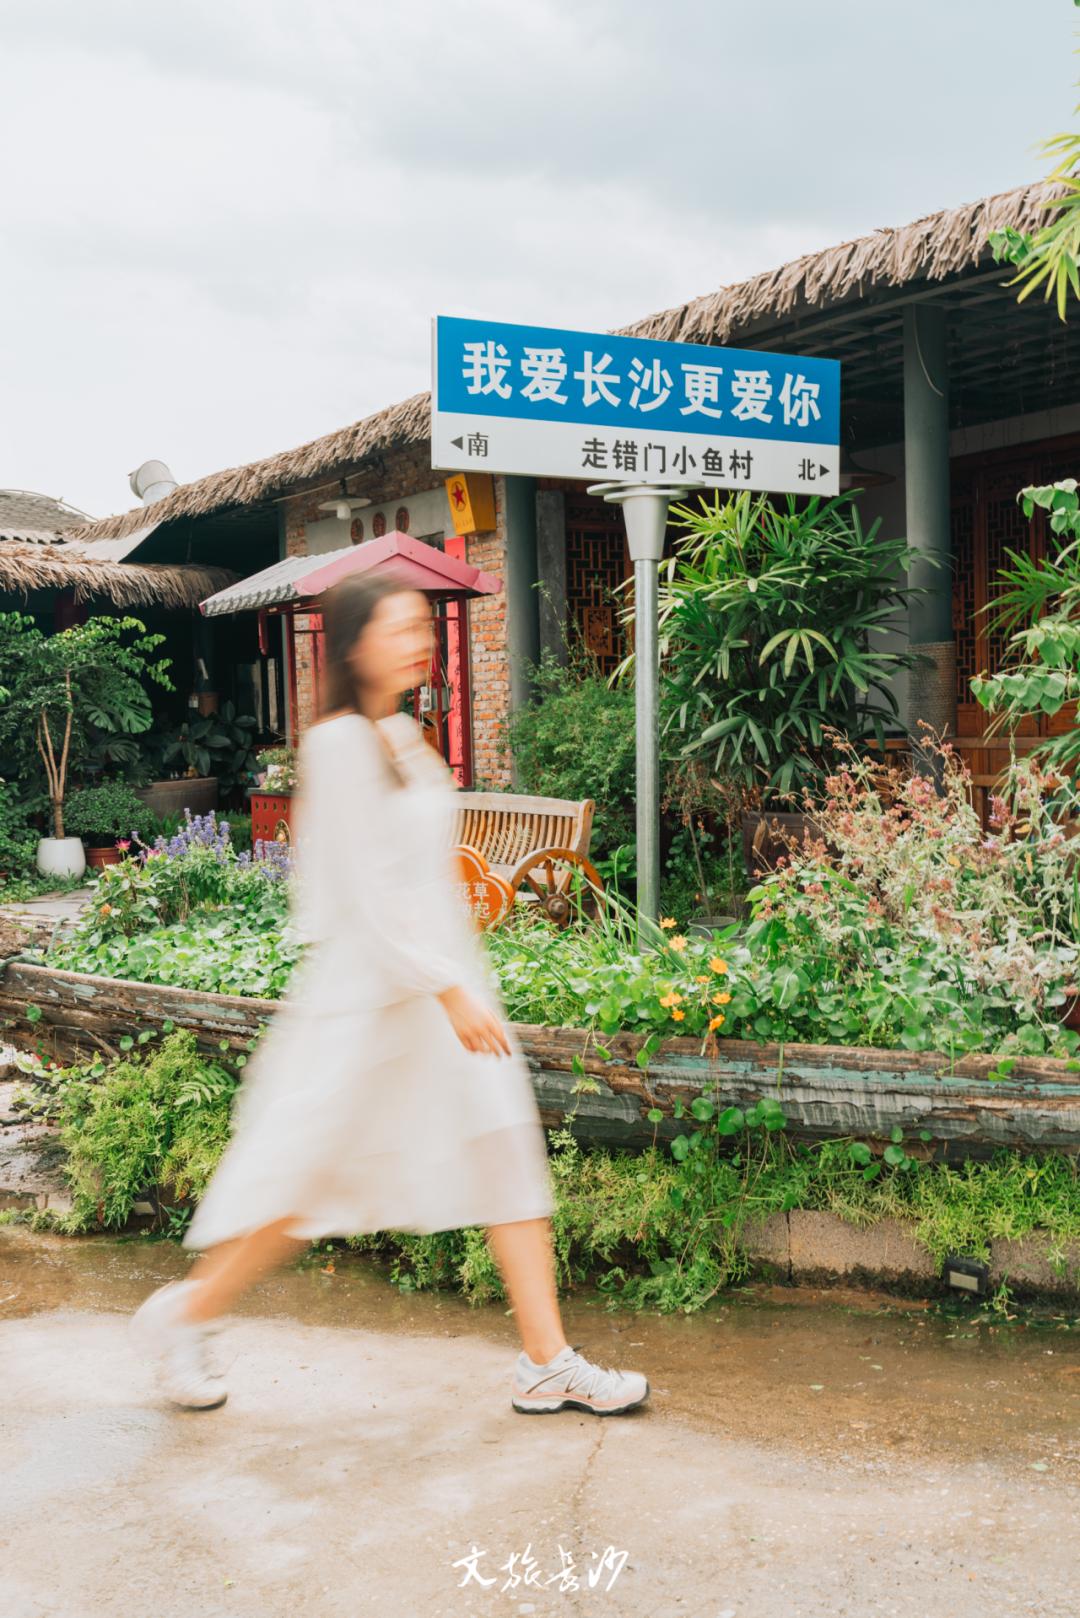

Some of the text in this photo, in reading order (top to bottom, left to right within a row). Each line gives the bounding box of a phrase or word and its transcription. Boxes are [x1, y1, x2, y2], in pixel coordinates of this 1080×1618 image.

[462, 340, 822, 428] 我爱长沙更爱你
[467, 432, 489, 458] 南
[581, 437, 754, 481] 走错门小鱼村
[798, 458, 817, 482] 北
